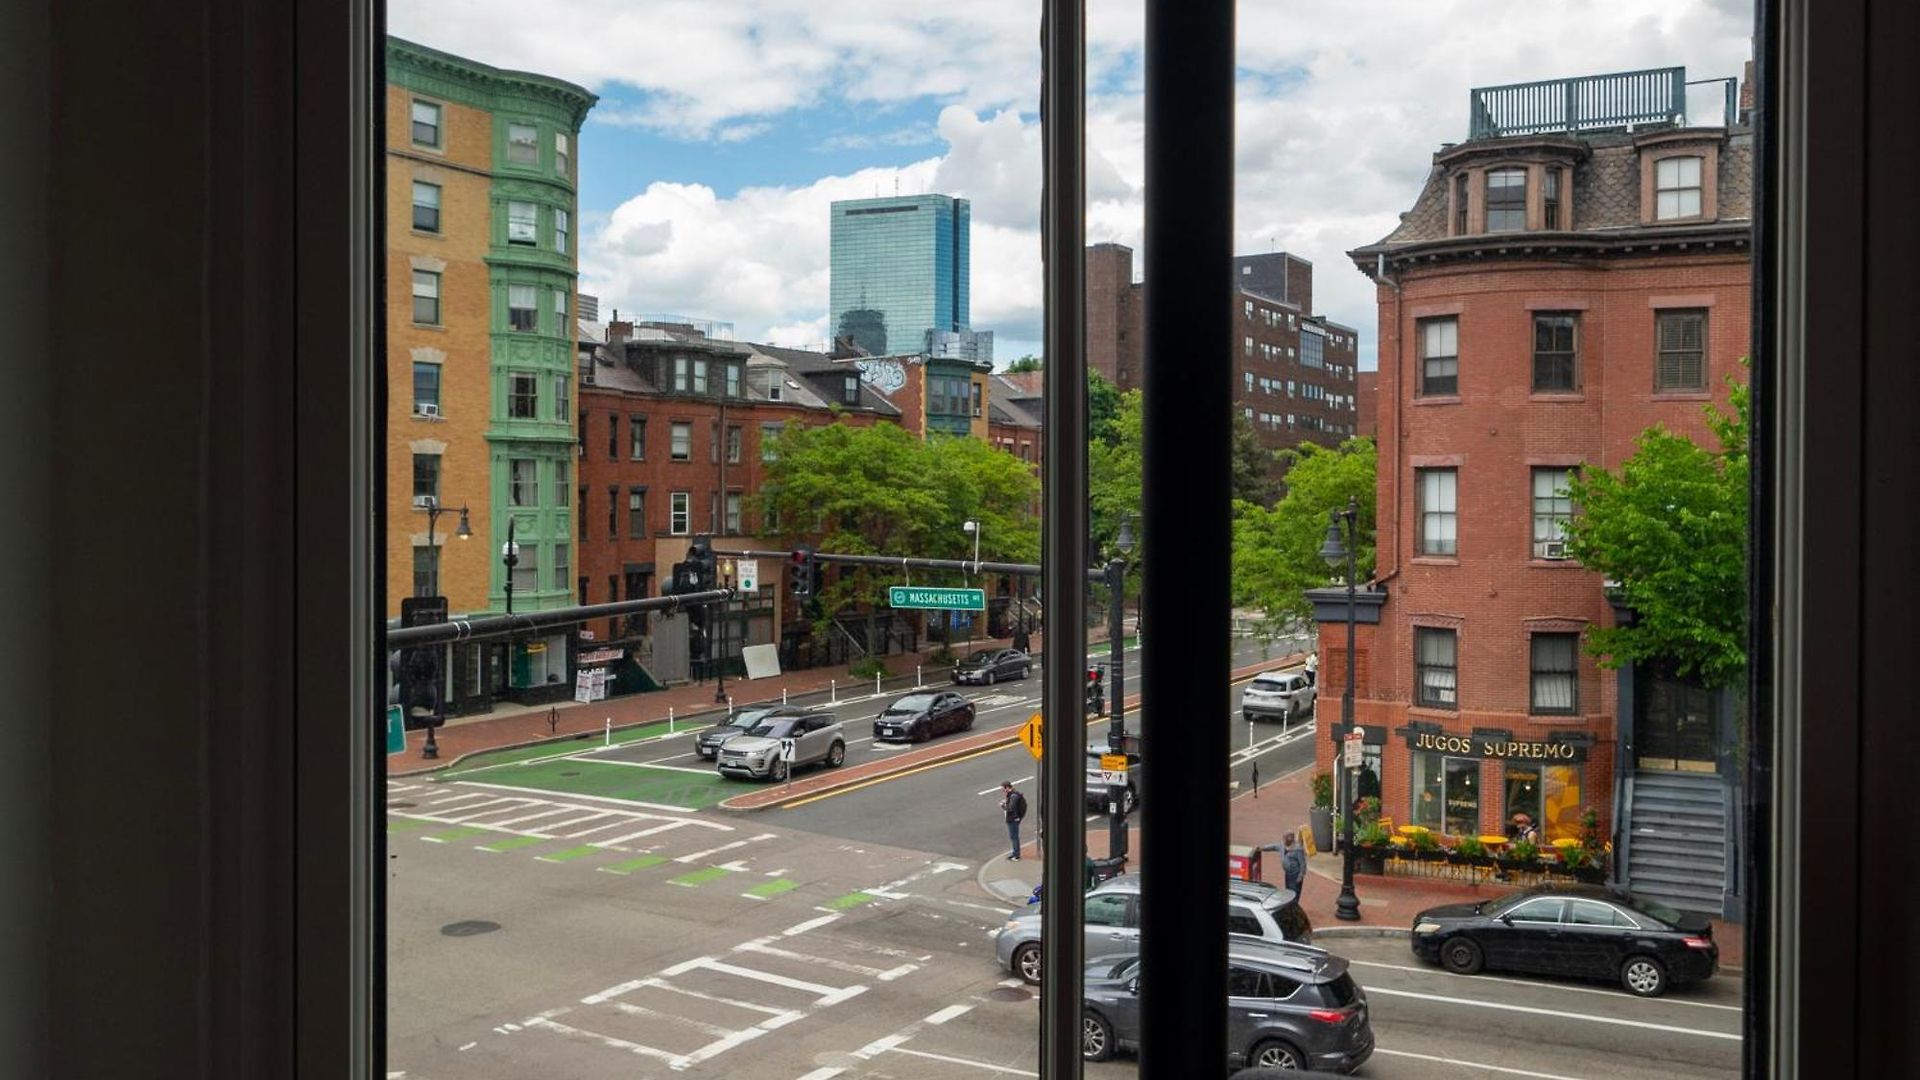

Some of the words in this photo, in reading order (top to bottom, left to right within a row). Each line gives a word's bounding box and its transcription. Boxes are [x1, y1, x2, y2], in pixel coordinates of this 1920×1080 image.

[909, 593, 969, 605] MASSACHUSETTS
[1416, 733, 1471, 753] JUGOS
[1484, 741, 1574, 759] SUPREMO
